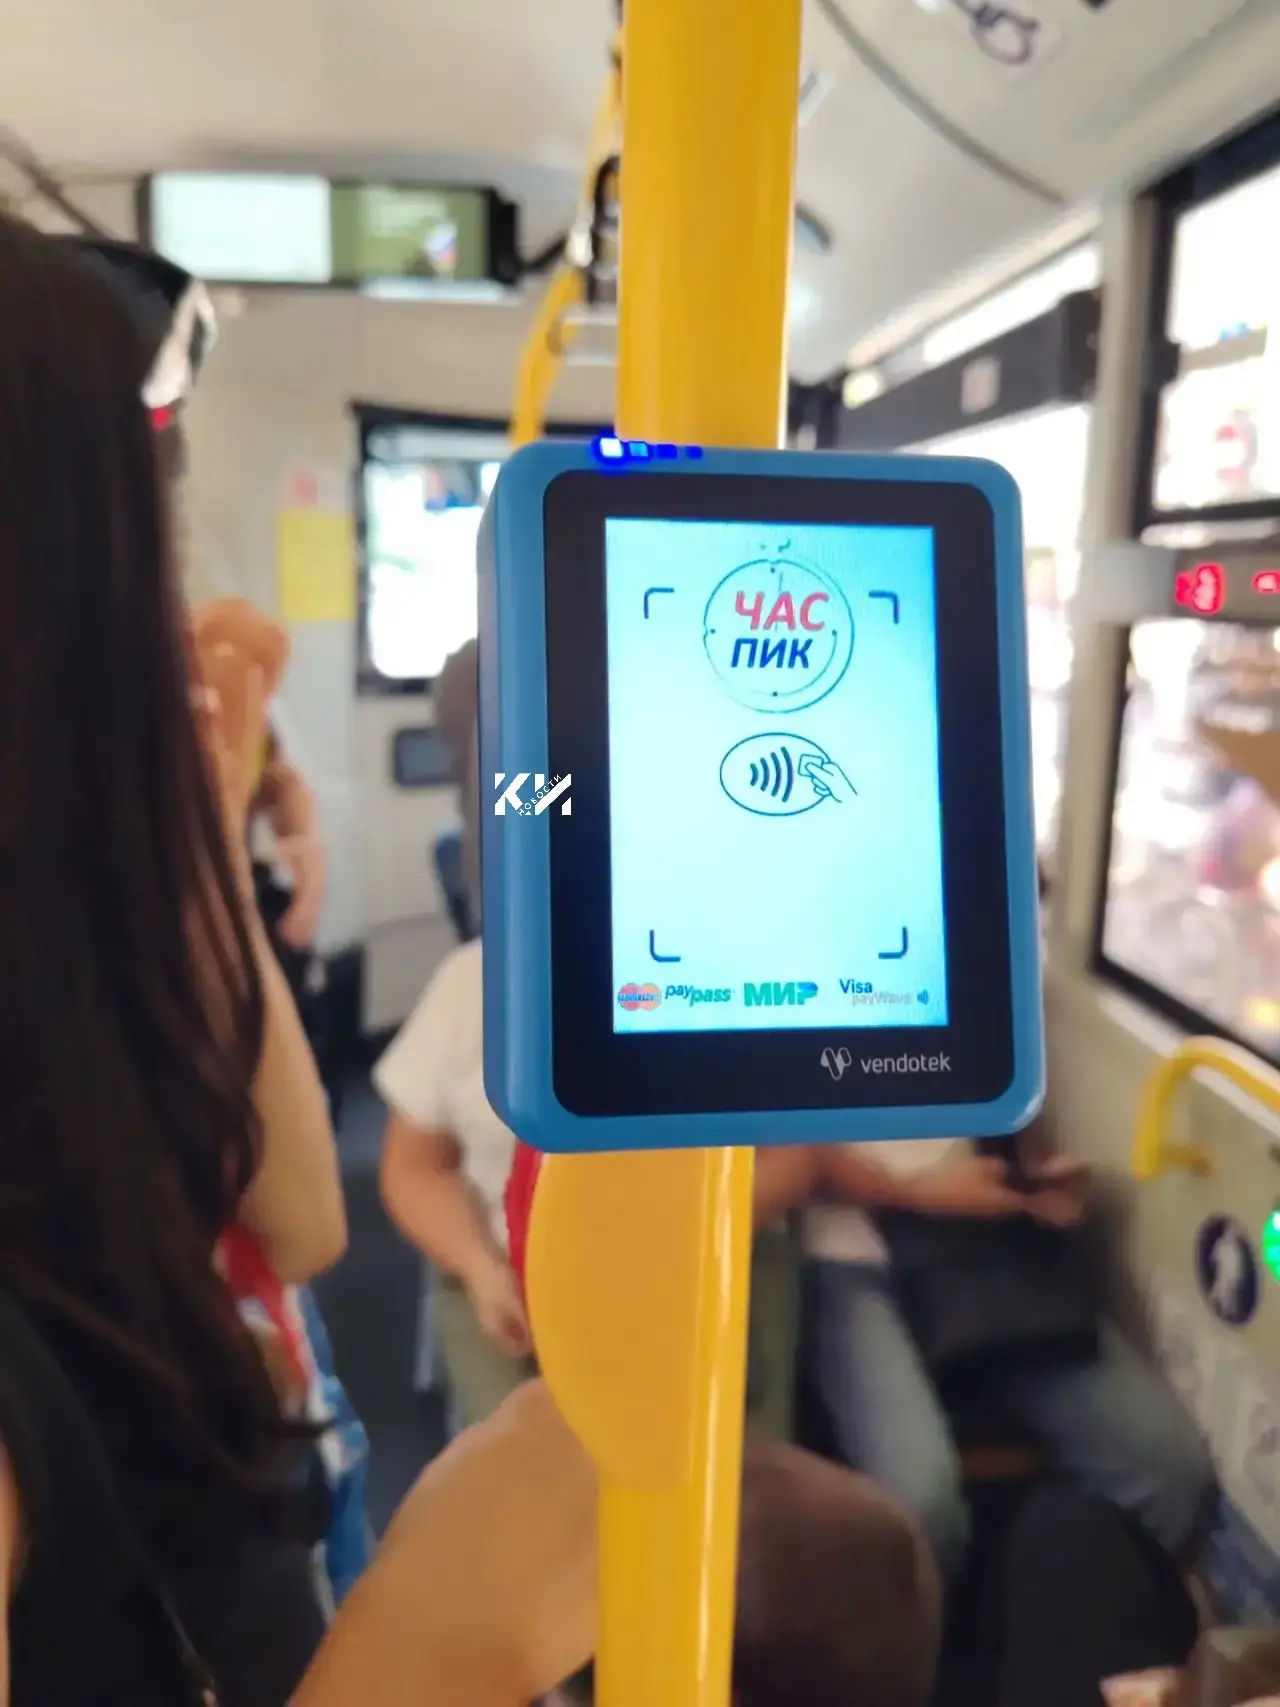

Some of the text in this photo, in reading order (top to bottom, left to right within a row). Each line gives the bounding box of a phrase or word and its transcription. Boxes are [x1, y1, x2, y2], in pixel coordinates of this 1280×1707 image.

[735, 591, 829, 631] ЧАС
[731, 638, 813, 668] ПИК
[744, 982, 818, 1006] МИР
[839, 979, 873, 993] Visa
[861, 1052, 951, 1073] vendotek
